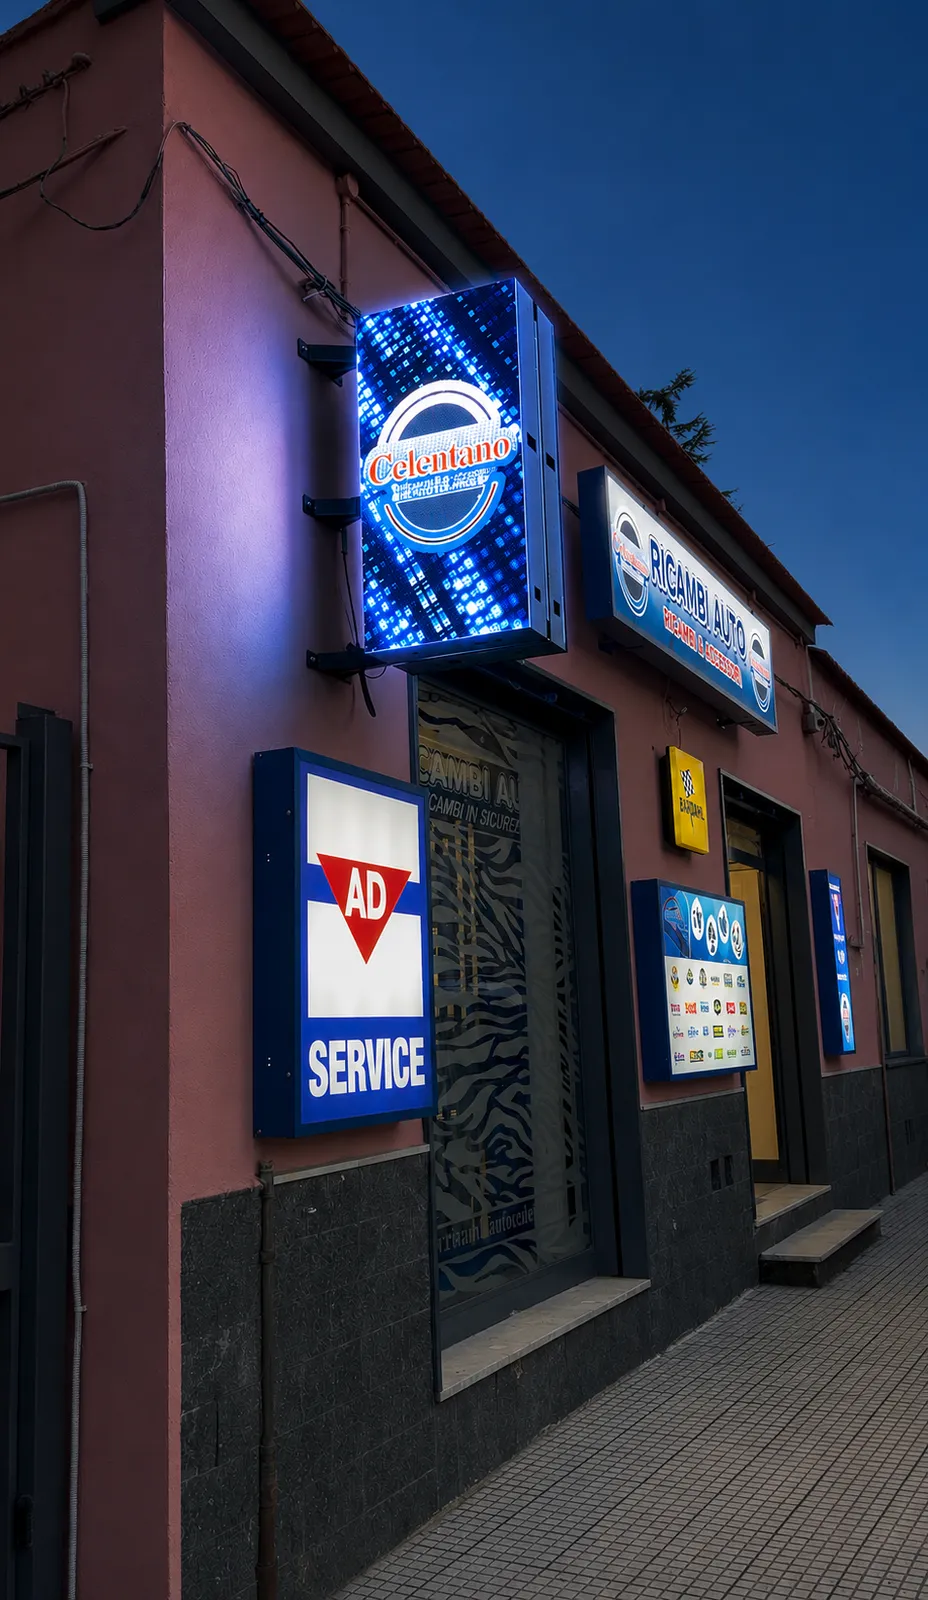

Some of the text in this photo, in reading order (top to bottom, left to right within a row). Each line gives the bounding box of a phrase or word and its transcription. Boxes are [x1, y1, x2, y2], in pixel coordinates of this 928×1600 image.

[369, 438, 510, 484] Celentano
[650, 535, 709, 630] RICAMBI
[713, 596, 746, 659] AUTO
[465, 804, 478, 823] IN
[345, 867, 387, 920] AD
[308, 1036, 426, 1098] SERVICE
